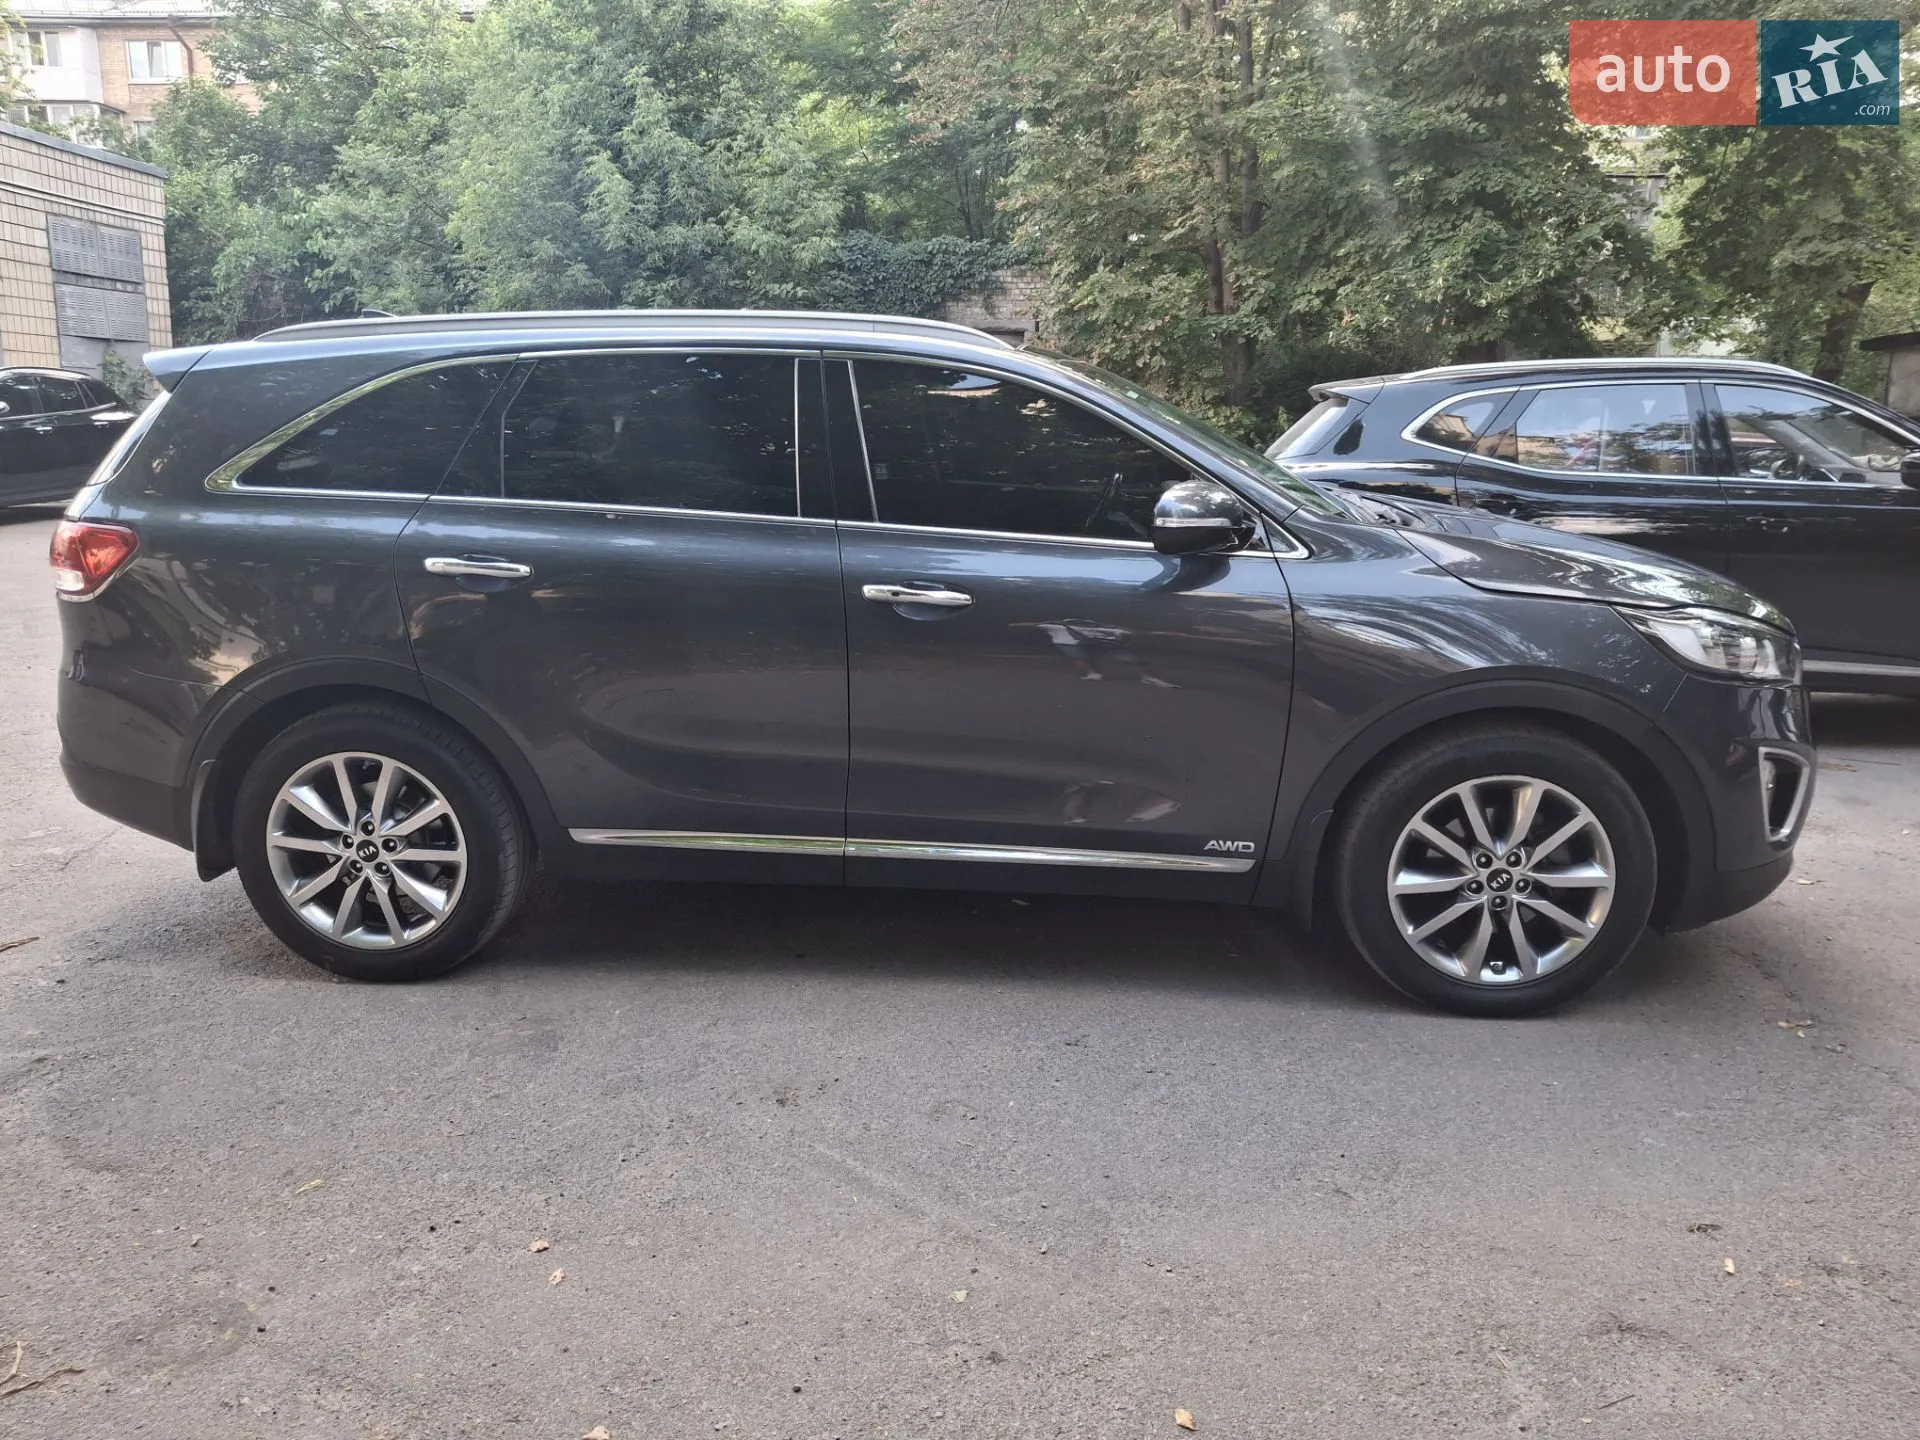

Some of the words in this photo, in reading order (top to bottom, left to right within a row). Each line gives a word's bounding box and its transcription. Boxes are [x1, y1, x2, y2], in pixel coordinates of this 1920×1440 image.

[358, 845, 377, 858] KIA
[1203, 839, 1255, 853] AWD
[1490, 873, 1511, 889] KIA
